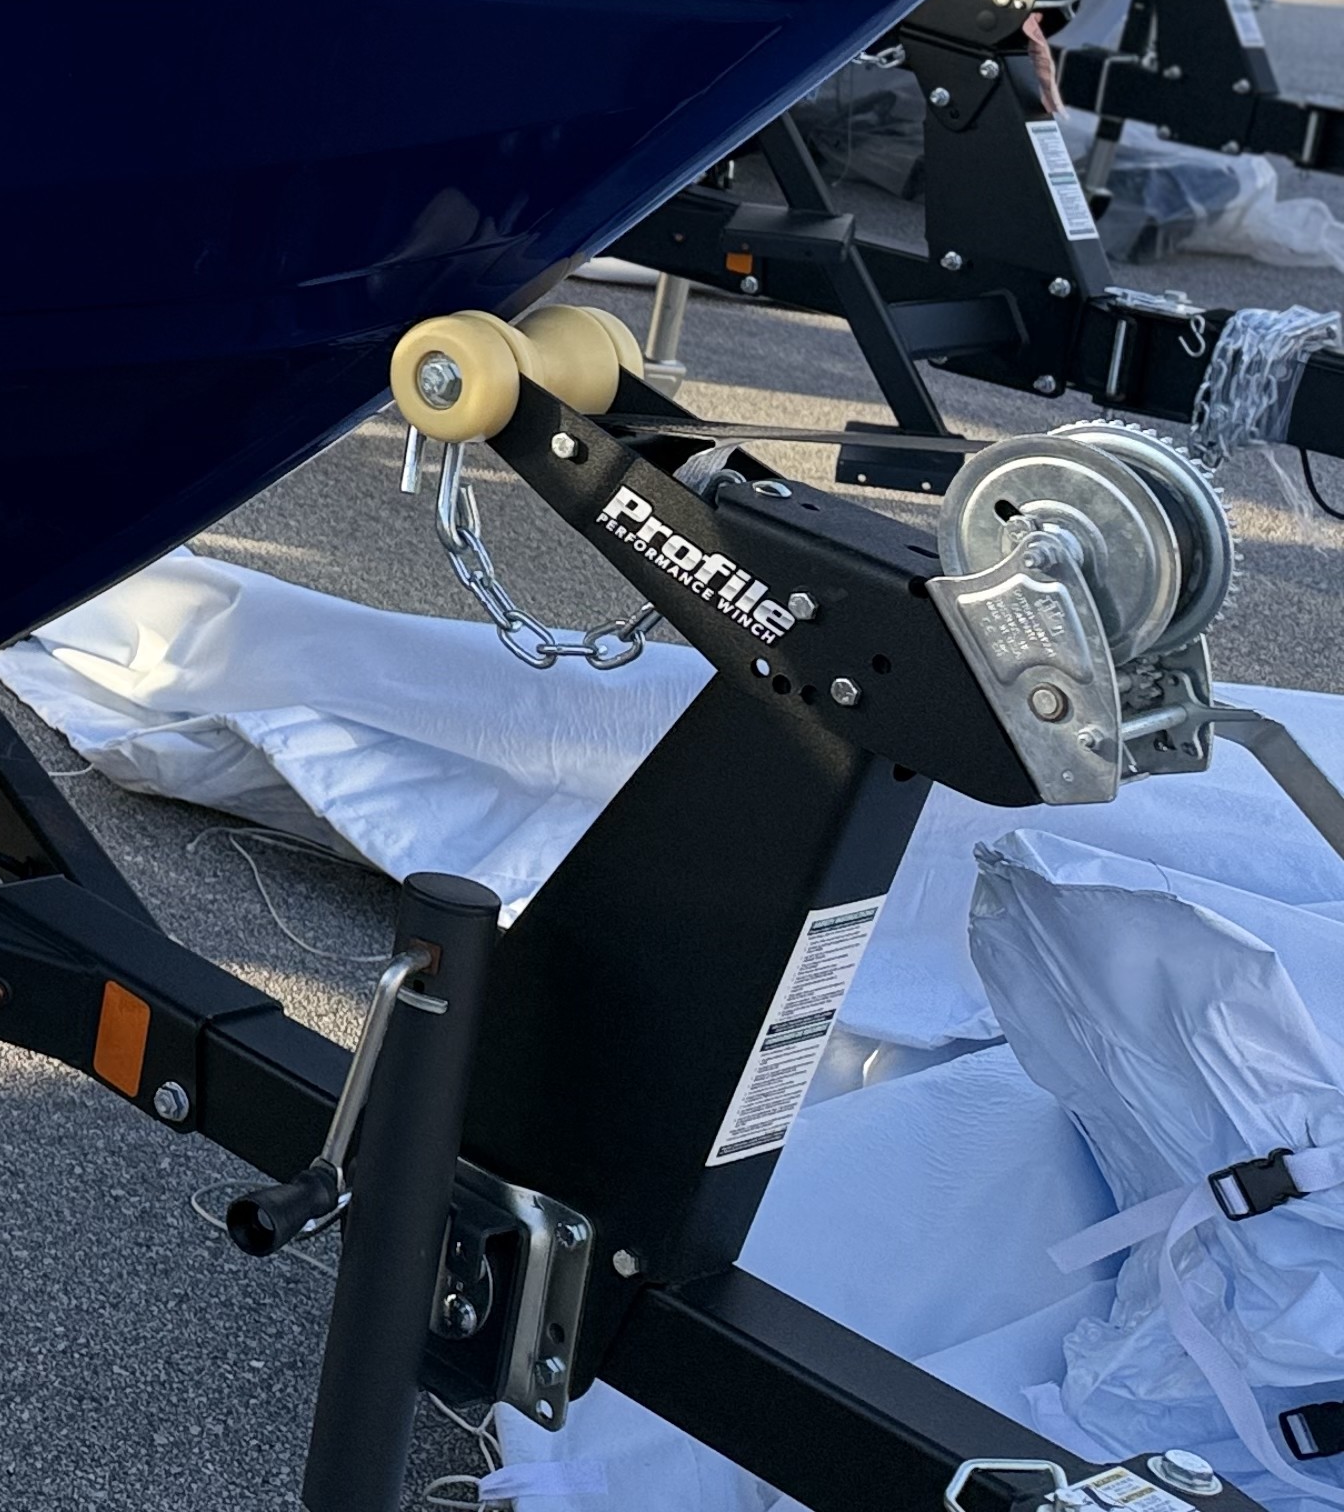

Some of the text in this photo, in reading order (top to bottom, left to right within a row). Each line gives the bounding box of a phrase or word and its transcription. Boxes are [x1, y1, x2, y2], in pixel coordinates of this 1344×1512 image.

[596, 512, 777, 645] PERFORMANCE WINCH
[602, 485, 796, 638] Profile
